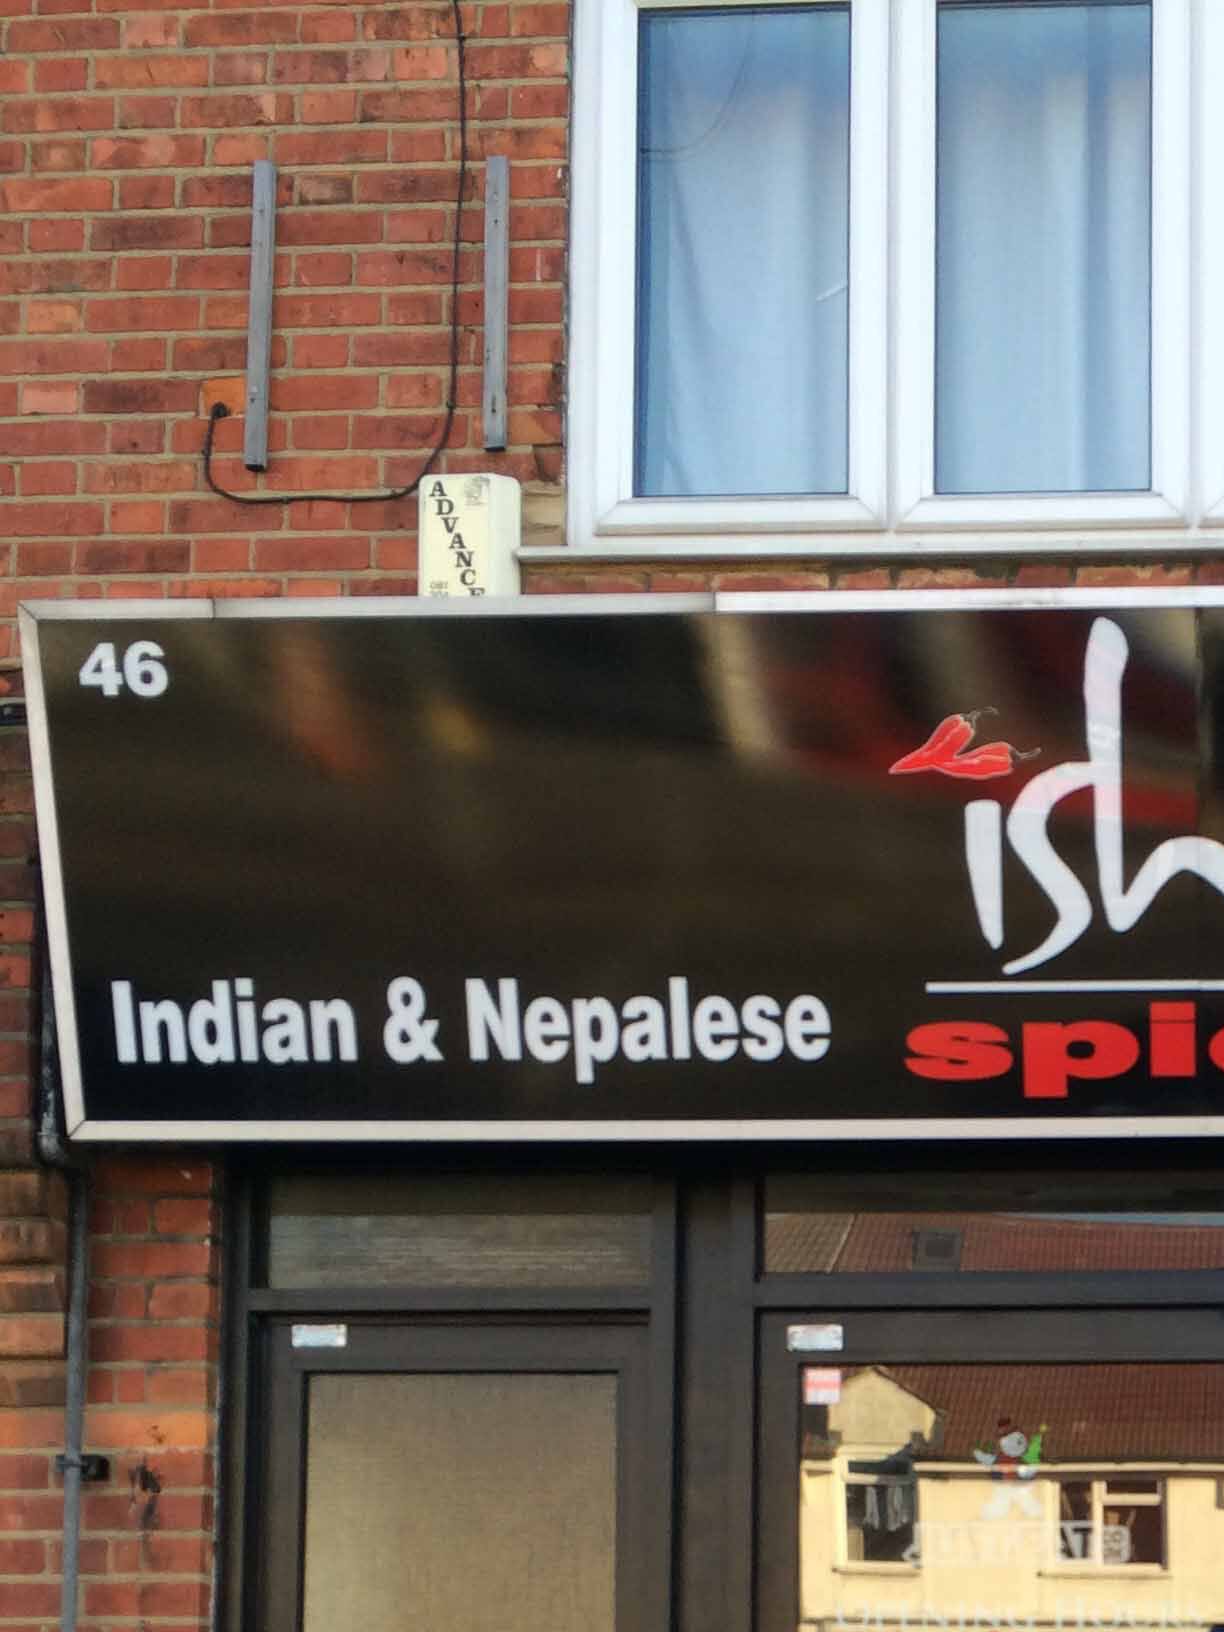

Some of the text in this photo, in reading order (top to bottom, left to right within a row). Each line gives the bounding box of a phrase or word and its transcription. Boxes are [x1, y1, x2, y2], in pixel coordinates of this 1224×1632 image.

[79, 641, 169, 697] 46
[111, 976, 832, 1084] Indian & Nepalese
